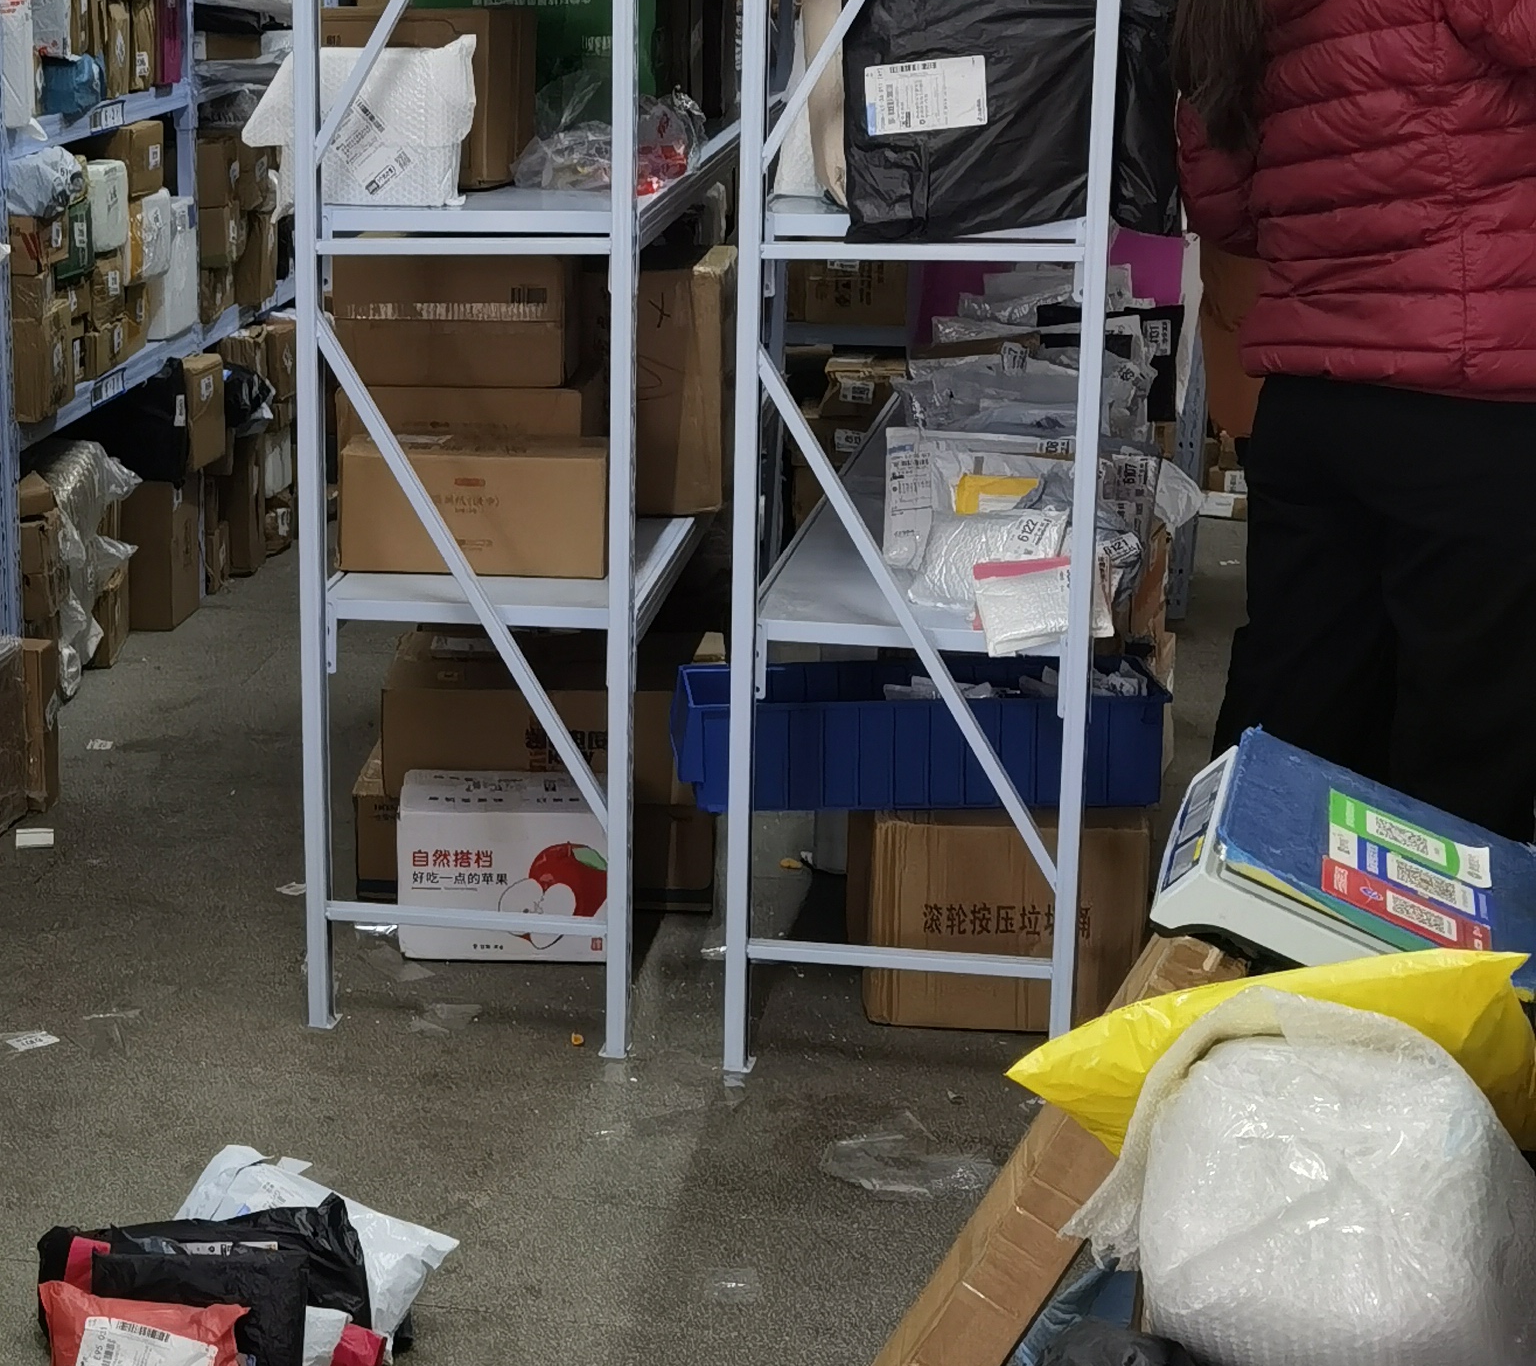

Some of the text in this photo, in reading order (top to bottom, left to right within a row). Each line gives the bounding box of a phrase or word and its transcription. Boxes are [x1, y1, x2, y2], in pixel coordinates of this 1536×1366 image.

[1018, 519, 1036, 542] 6122
[412, 848, 494, 869] 自然搭档
[412, 870, 509, 886] 好吃一点的苹果
